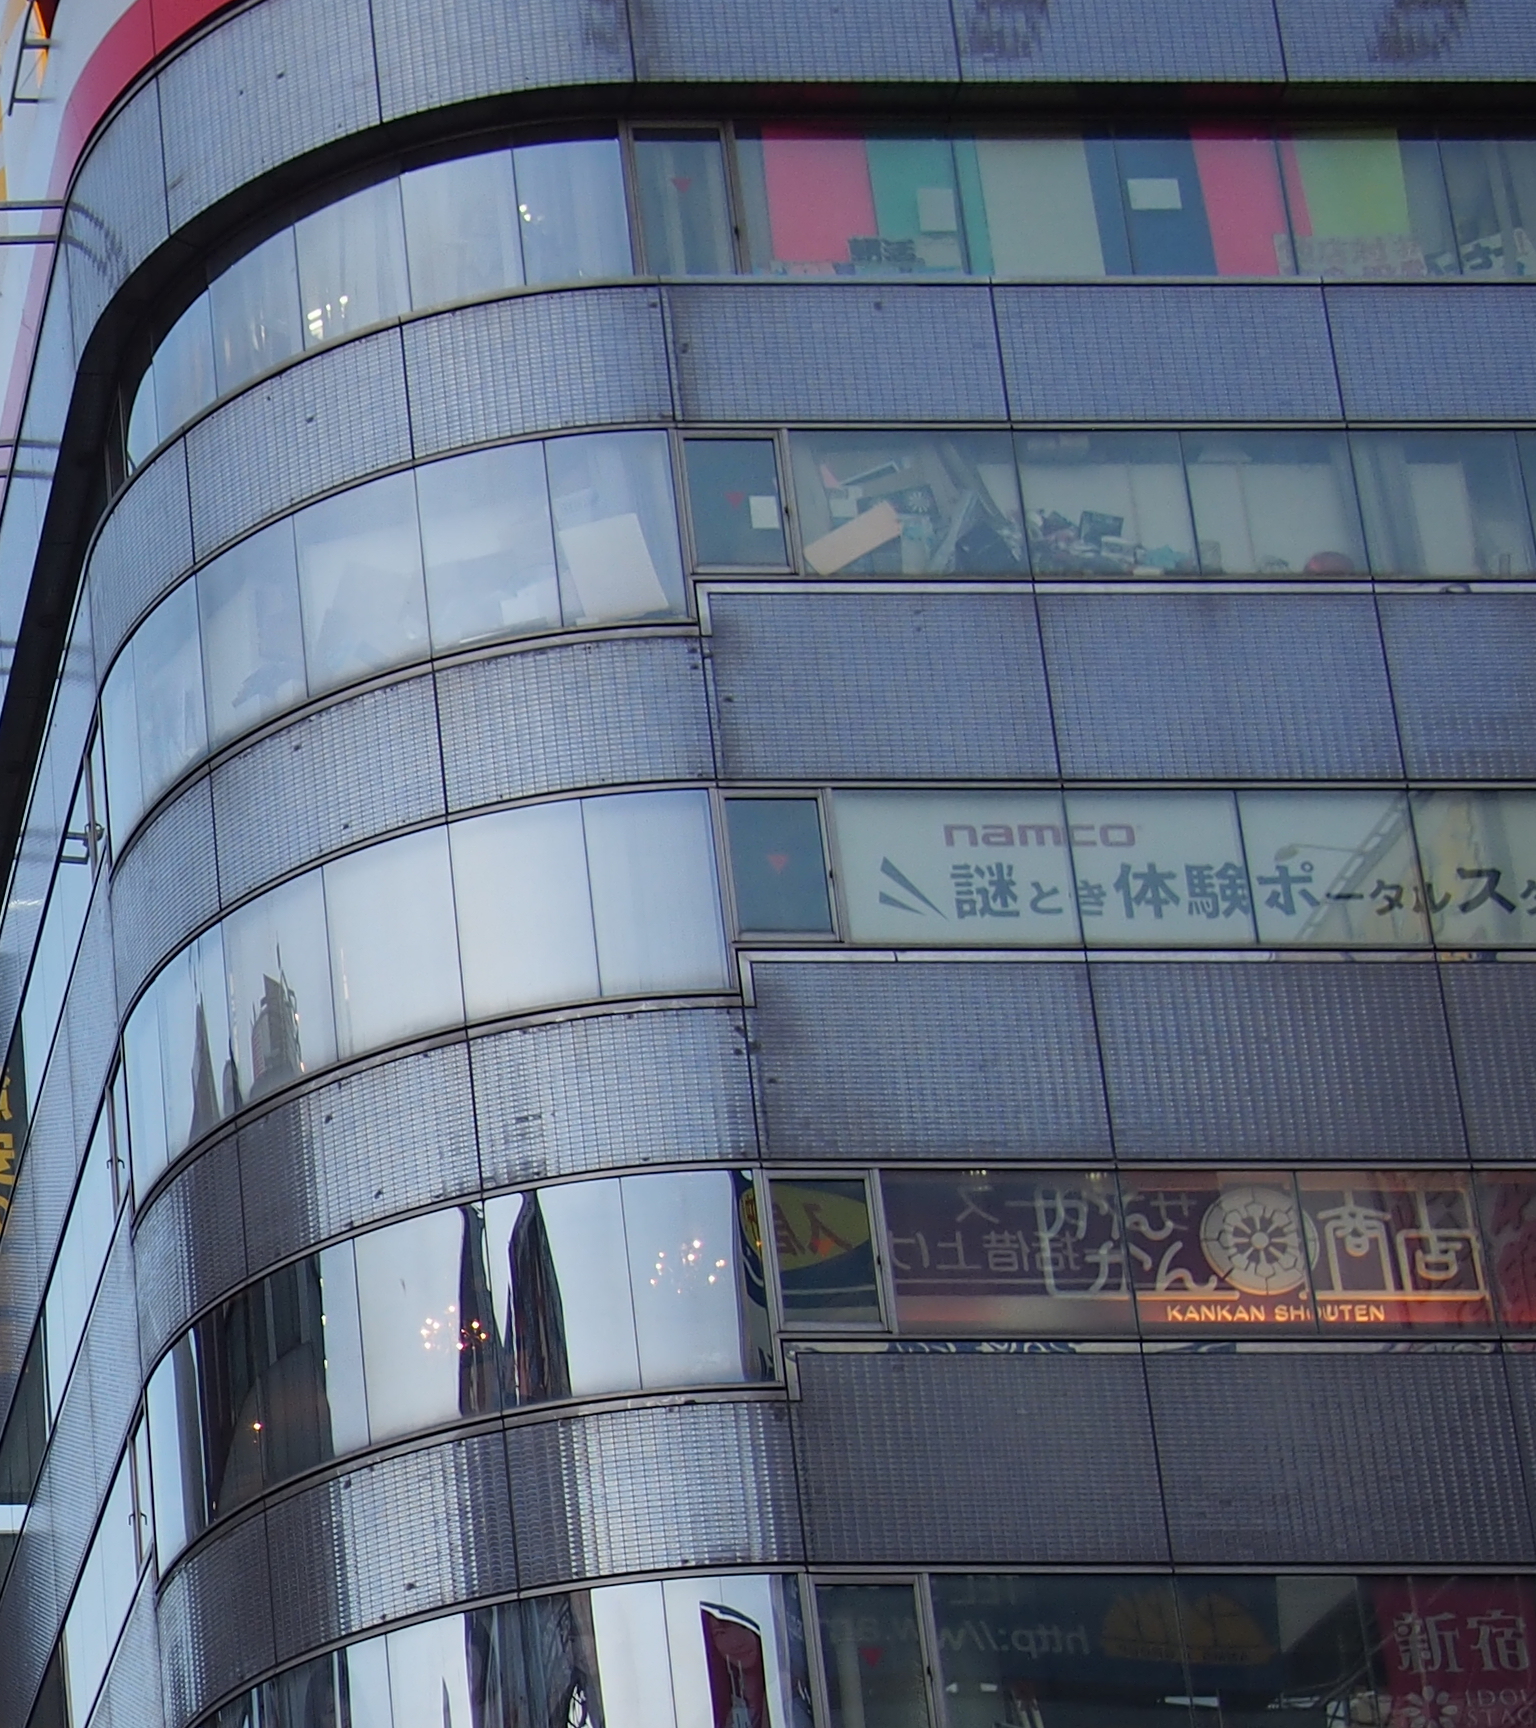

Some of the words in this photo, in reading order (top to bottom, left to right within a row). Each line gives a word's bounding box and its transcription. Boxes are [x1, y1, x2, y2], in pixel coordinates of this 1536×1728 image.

[943, 822, 1141, 851] namco
[1166, 1304, 1265, 1322] KANKAN
[1274, 1305, 1386, 1322] SHOUTEN
